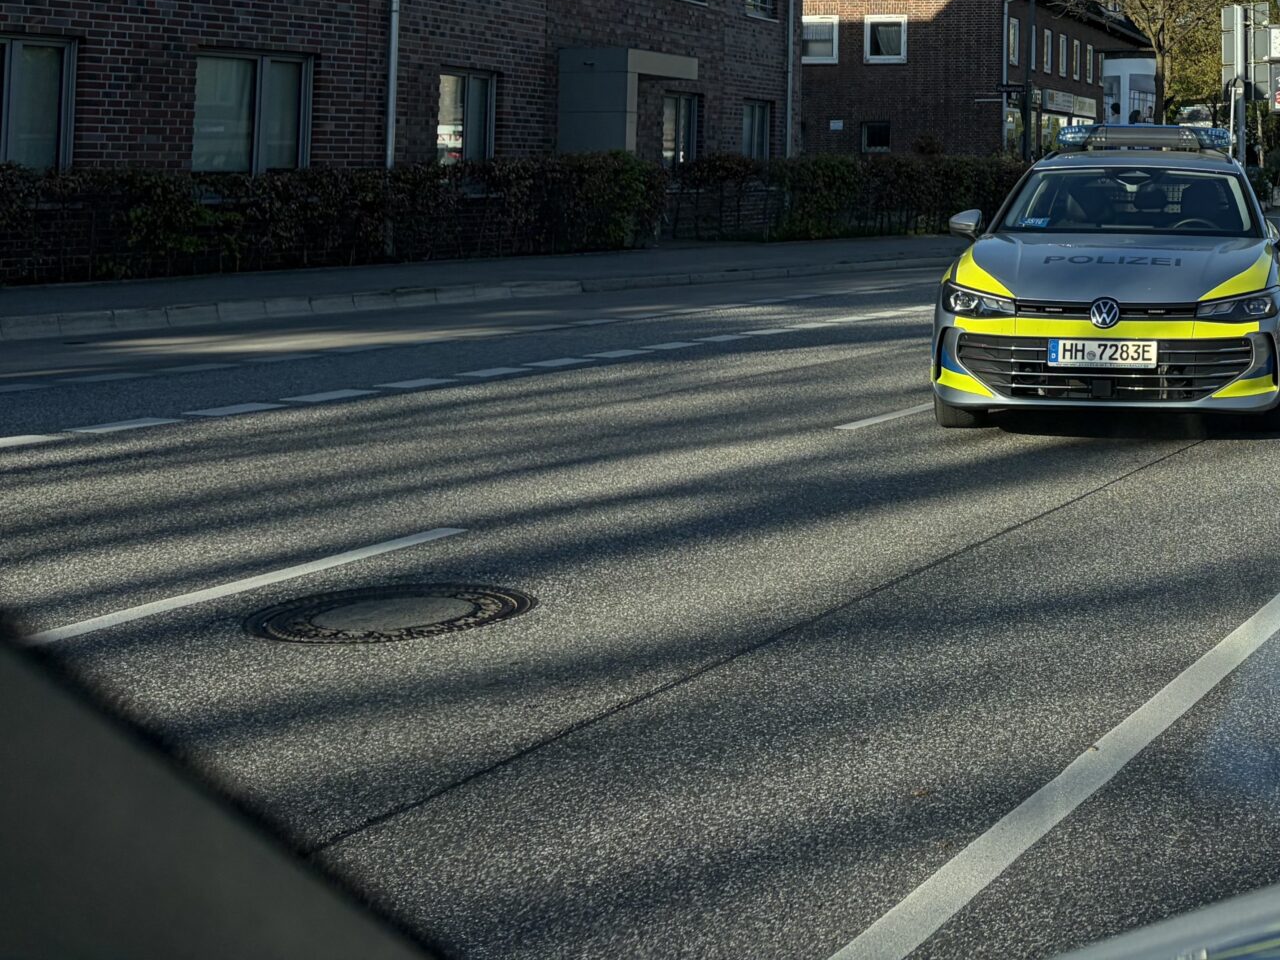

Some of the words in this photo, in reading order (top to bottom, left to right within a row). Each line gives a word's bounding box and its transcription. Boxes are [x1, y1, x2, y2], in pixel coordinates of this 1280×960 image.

[1043, 255, 1183, 267] POLIZEI
[1062, 342, 1086, 361] HH
[1097, 343, 1153, 362] 7283E
